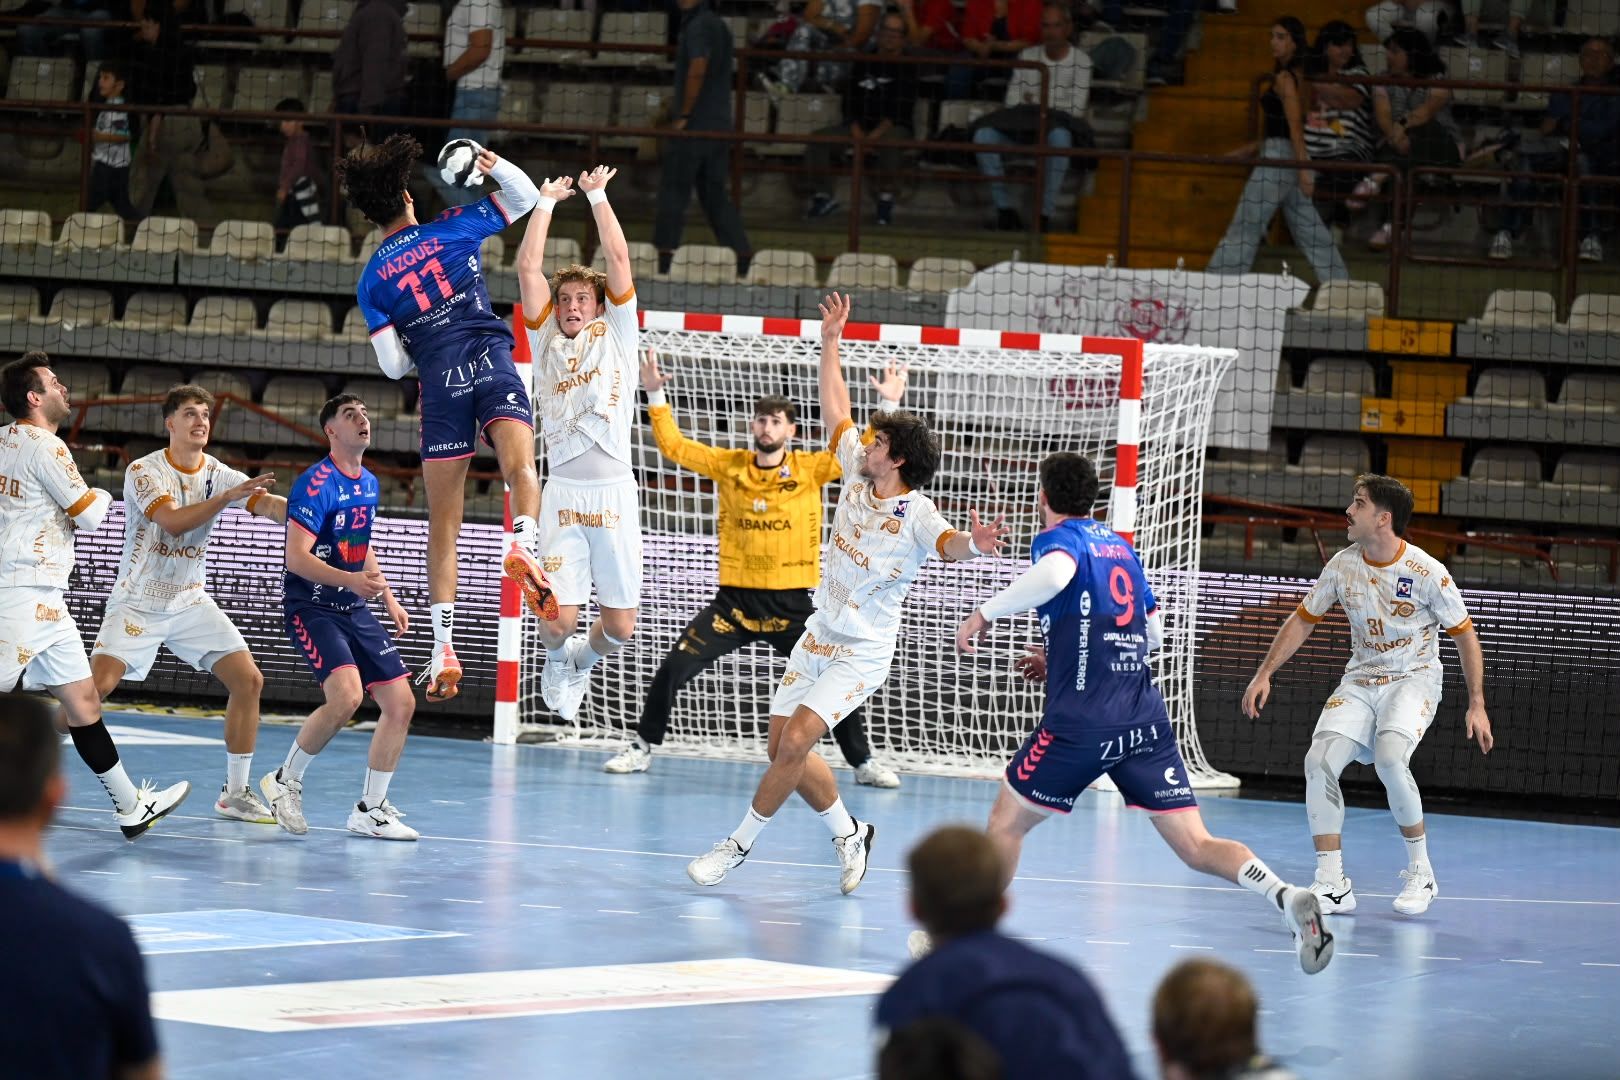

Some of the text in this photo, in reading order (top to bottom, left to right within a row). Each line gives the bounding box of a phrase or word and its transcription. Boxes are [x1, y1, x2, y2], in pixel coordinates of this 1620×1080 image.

[376, 237, 444, 281] VÁZQUEZ
[396, 257, 455, 313] 11
[446, 291, 466, 306] LEÓN
[428, 441, 469, 452] HUERCASA
[351, 506, 367, 530] 25
[736, 518, 792, 531] ABANCA
[148, 541, 206, 560] ABANCA
[1405, 559, 1430, 578] alsa
[1109, 565, 1136, 628] 9
[1366, 618, 1384, 636] 31
[1076, 618, 1091, 691] HIPER HIERROS
[1031, 789, 1074, 806] HUERCAS
